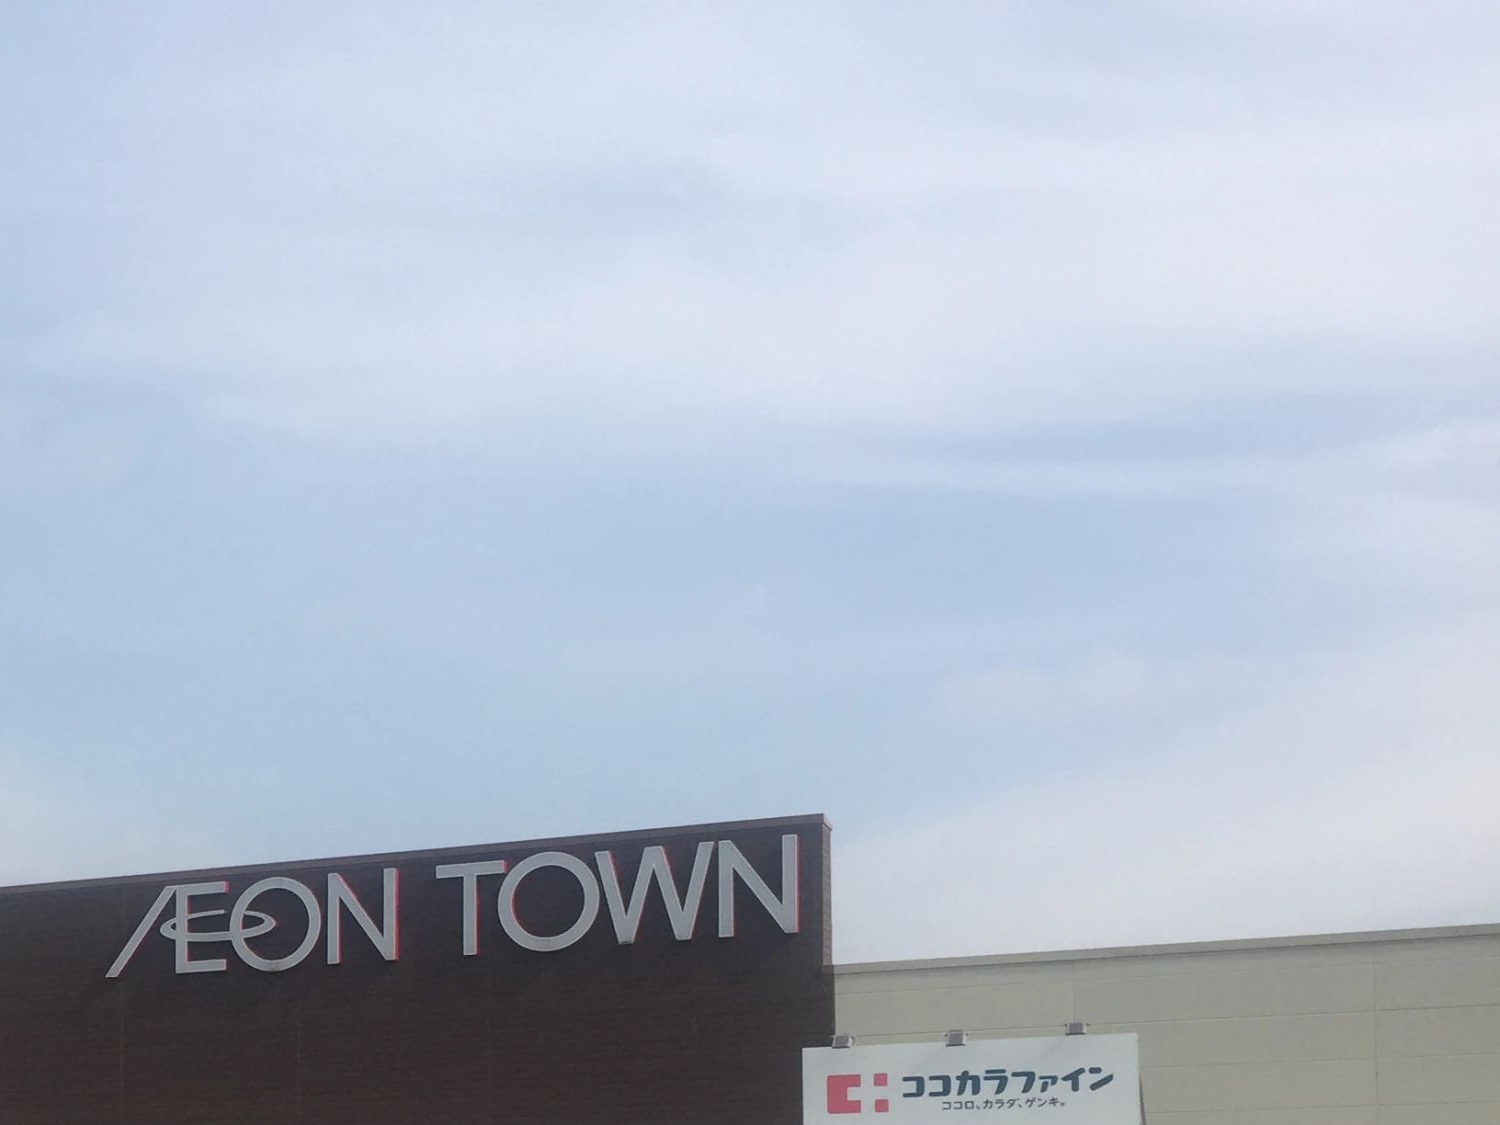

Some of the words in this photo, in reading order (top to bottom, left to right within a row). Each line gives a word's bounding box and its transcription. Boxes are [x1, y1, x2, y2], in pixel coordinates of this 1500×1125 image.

[435, 833, 800, 957] TOWN
[902, 1066, 1115, 1099] ココカラファイン
